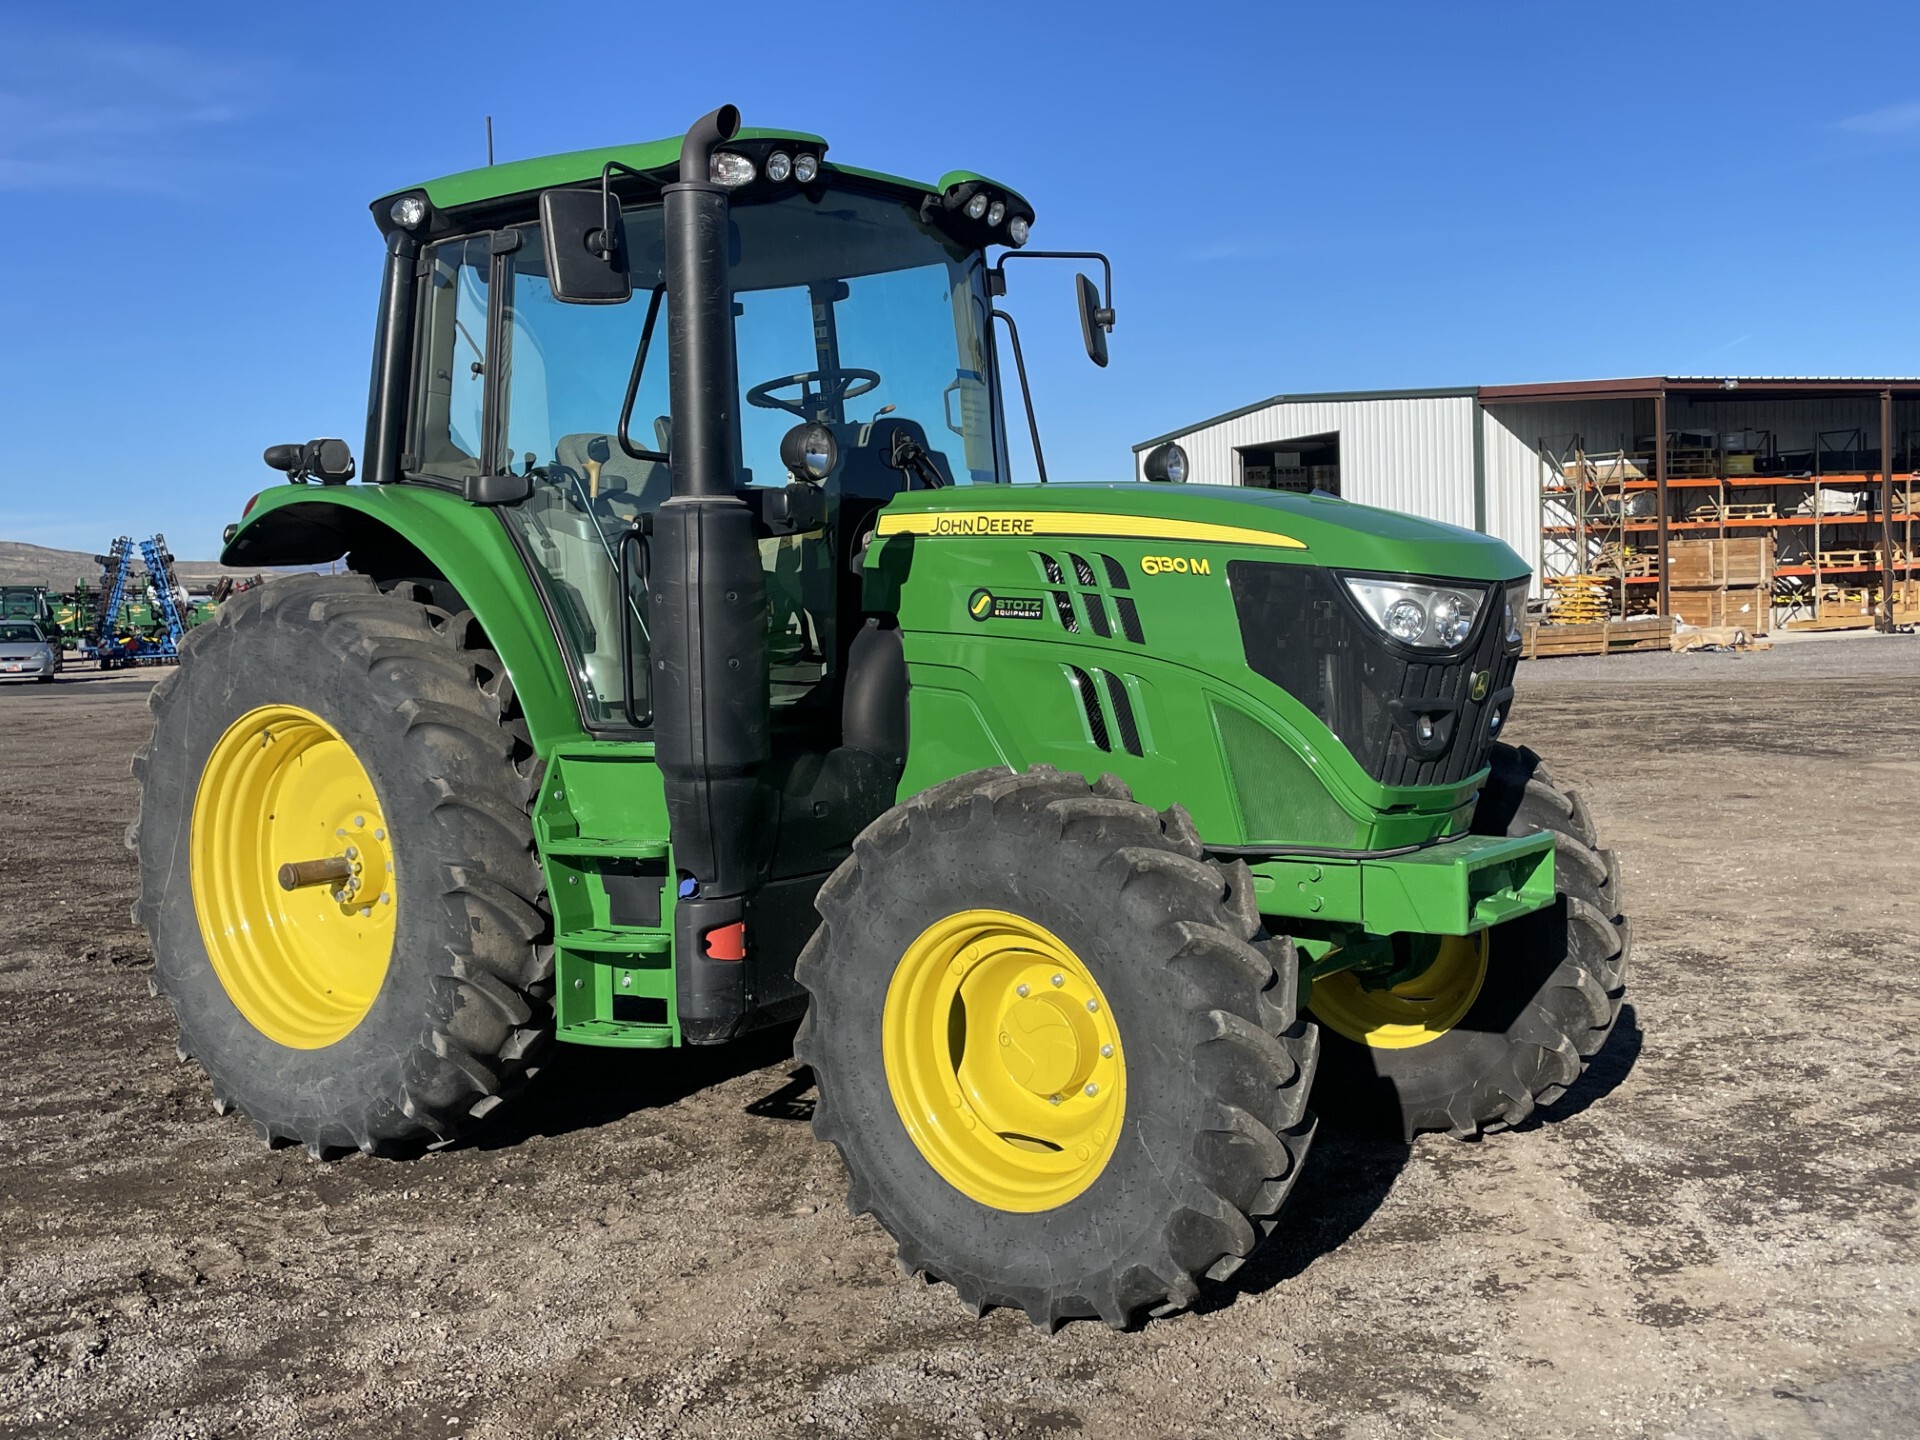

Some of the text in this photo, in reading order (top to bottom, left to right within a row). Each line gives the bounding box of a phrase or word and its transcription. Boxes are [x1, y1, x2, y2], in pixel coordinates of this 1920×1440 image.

[930, 516, 1034, 533] JOHN DEERE
[995, 600, 1041, 610] STOTZ
[995, 609, 1041, 617] EQUIPMENT
